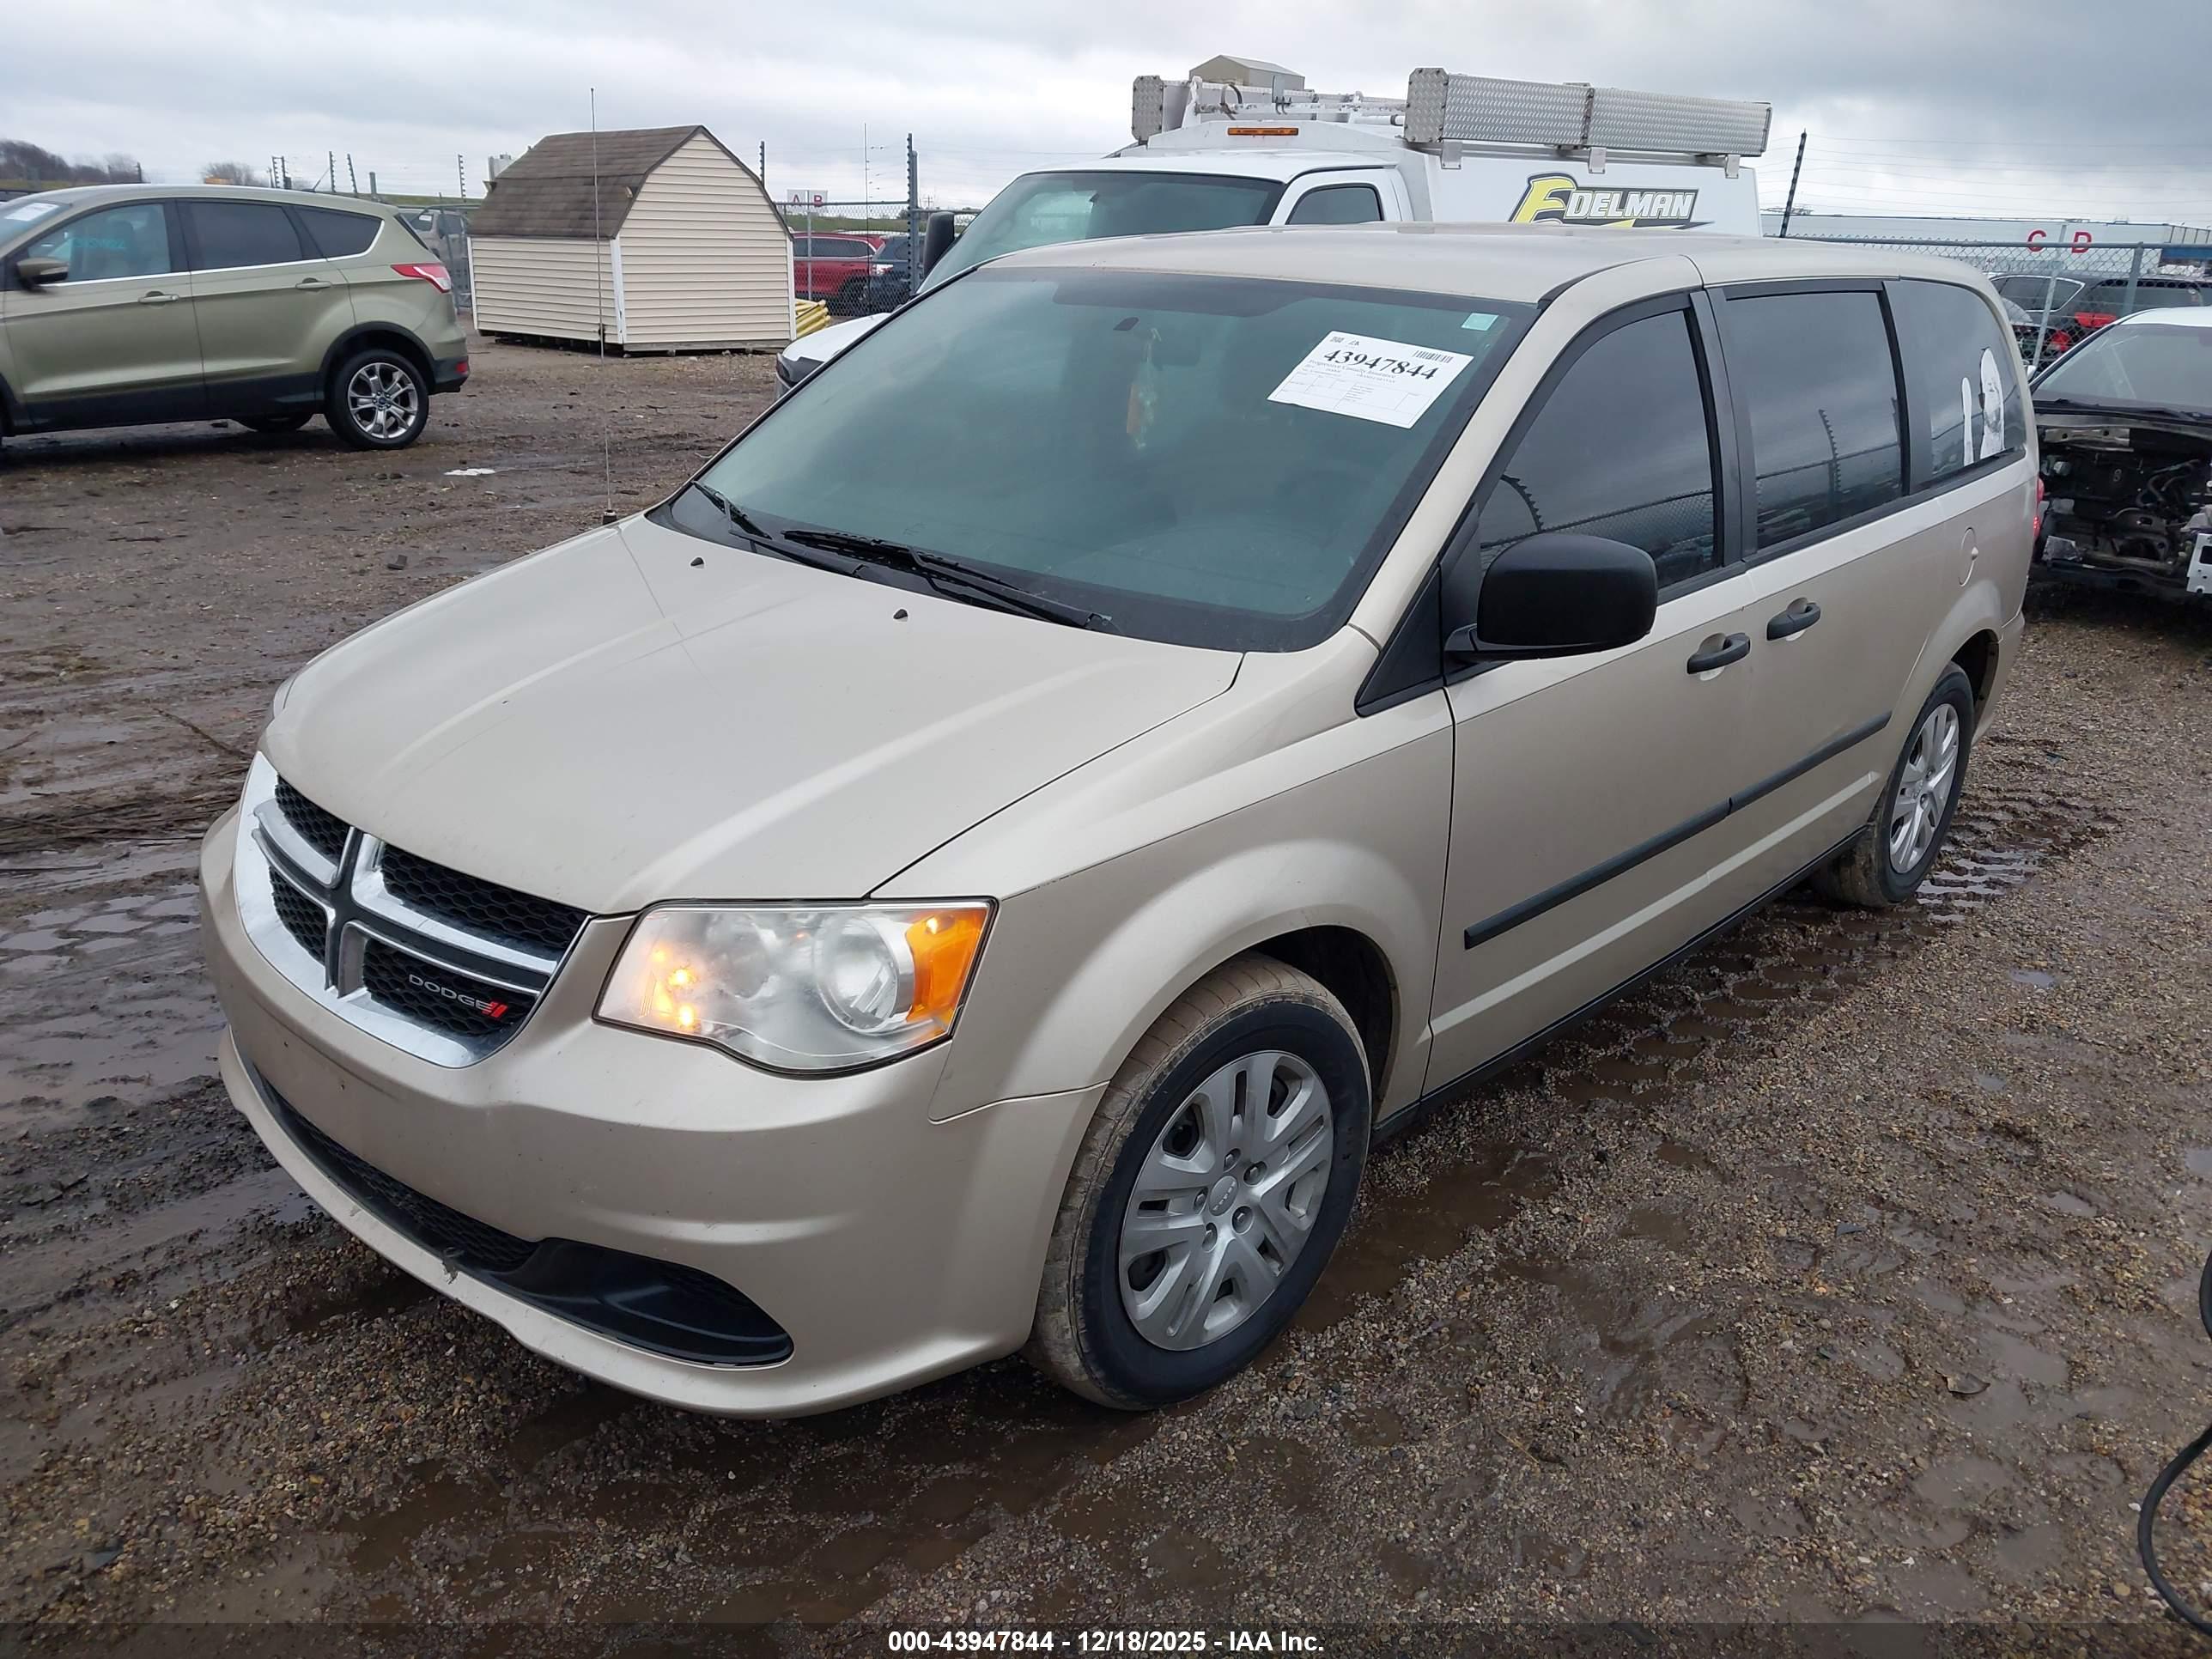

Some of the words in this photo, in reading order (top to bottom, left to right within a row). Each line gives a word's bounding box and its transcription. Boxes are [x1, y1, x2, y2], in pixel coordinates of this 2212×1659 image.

[1512, 174, 1696, 223] EDELMAN
[2027, 229, 2047, 252] C
[2071, 231, 2093, 253] D
[1323, 349, 1440, 380] 43947844
[409, 974, 493, 1013] DODGE
